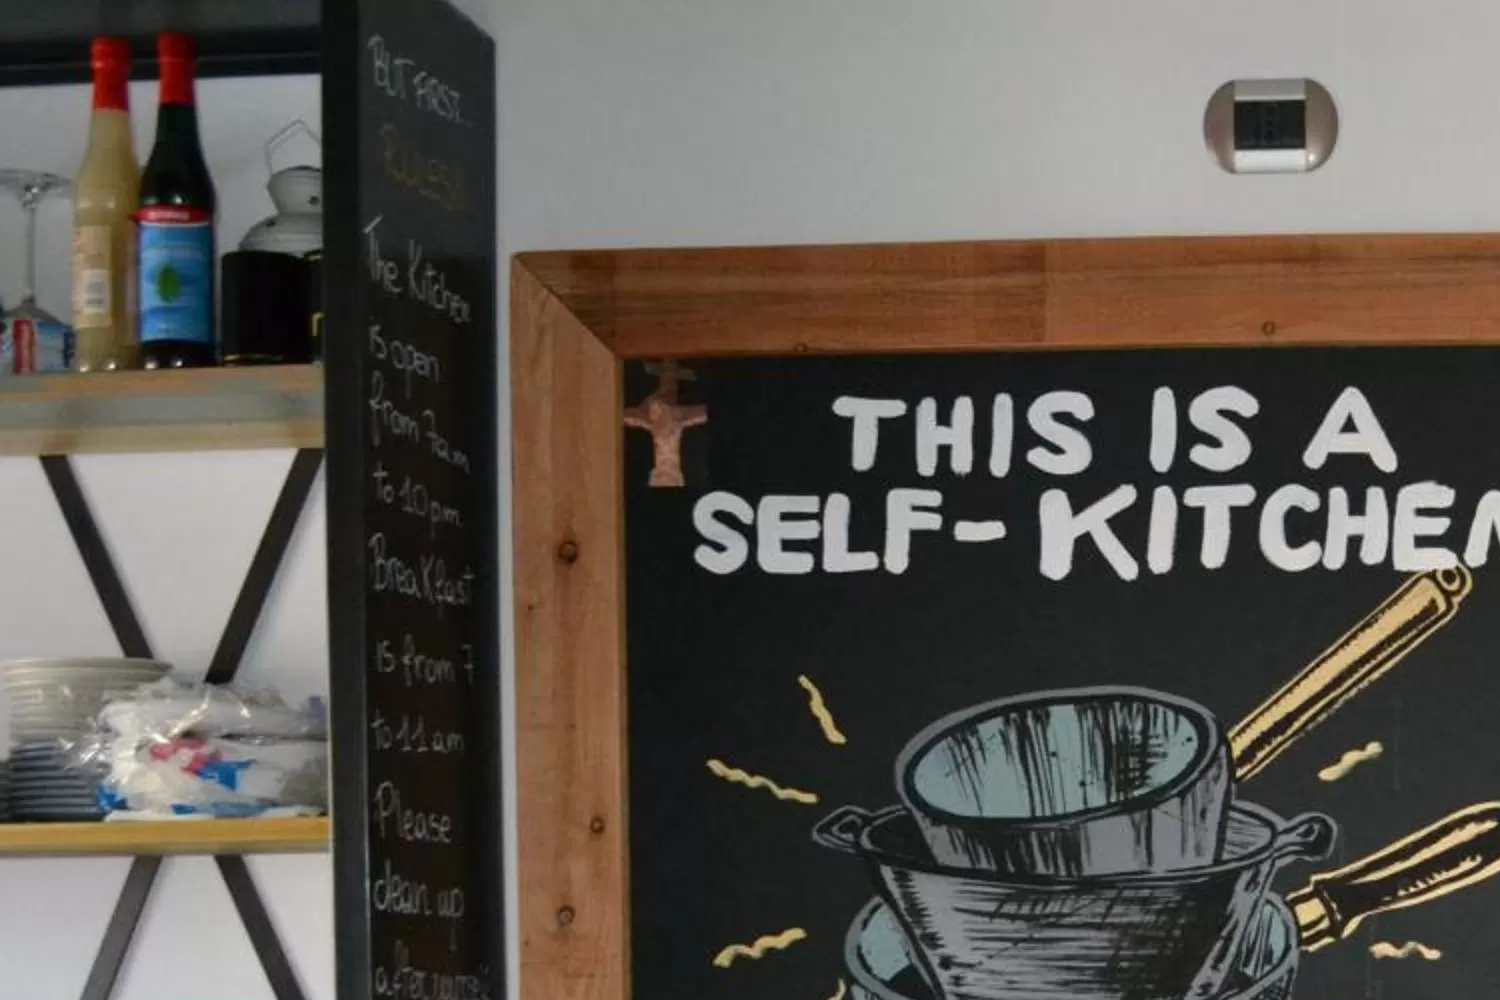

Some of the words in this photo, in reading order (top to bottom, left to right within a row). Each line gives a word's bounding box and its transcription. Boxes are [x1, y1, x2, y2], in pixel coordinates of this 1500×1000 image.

[362, 214, 404, 294] The
[389, 338, 441, 400] open
[368, 368, 420, 447] from
[831, 390, 1096, 478] THIS
[1149, 385, 1260, 474] IS
[1302, 385, 1399, 473] A
[372, 460, 396, 504] to
[401, 633, 455, 687] from
[371, 708, 393, 750] to
[374, 780, 452, 844] Please
[373, 859, 433, 915] clean
[436, 887, 465, 952] up
